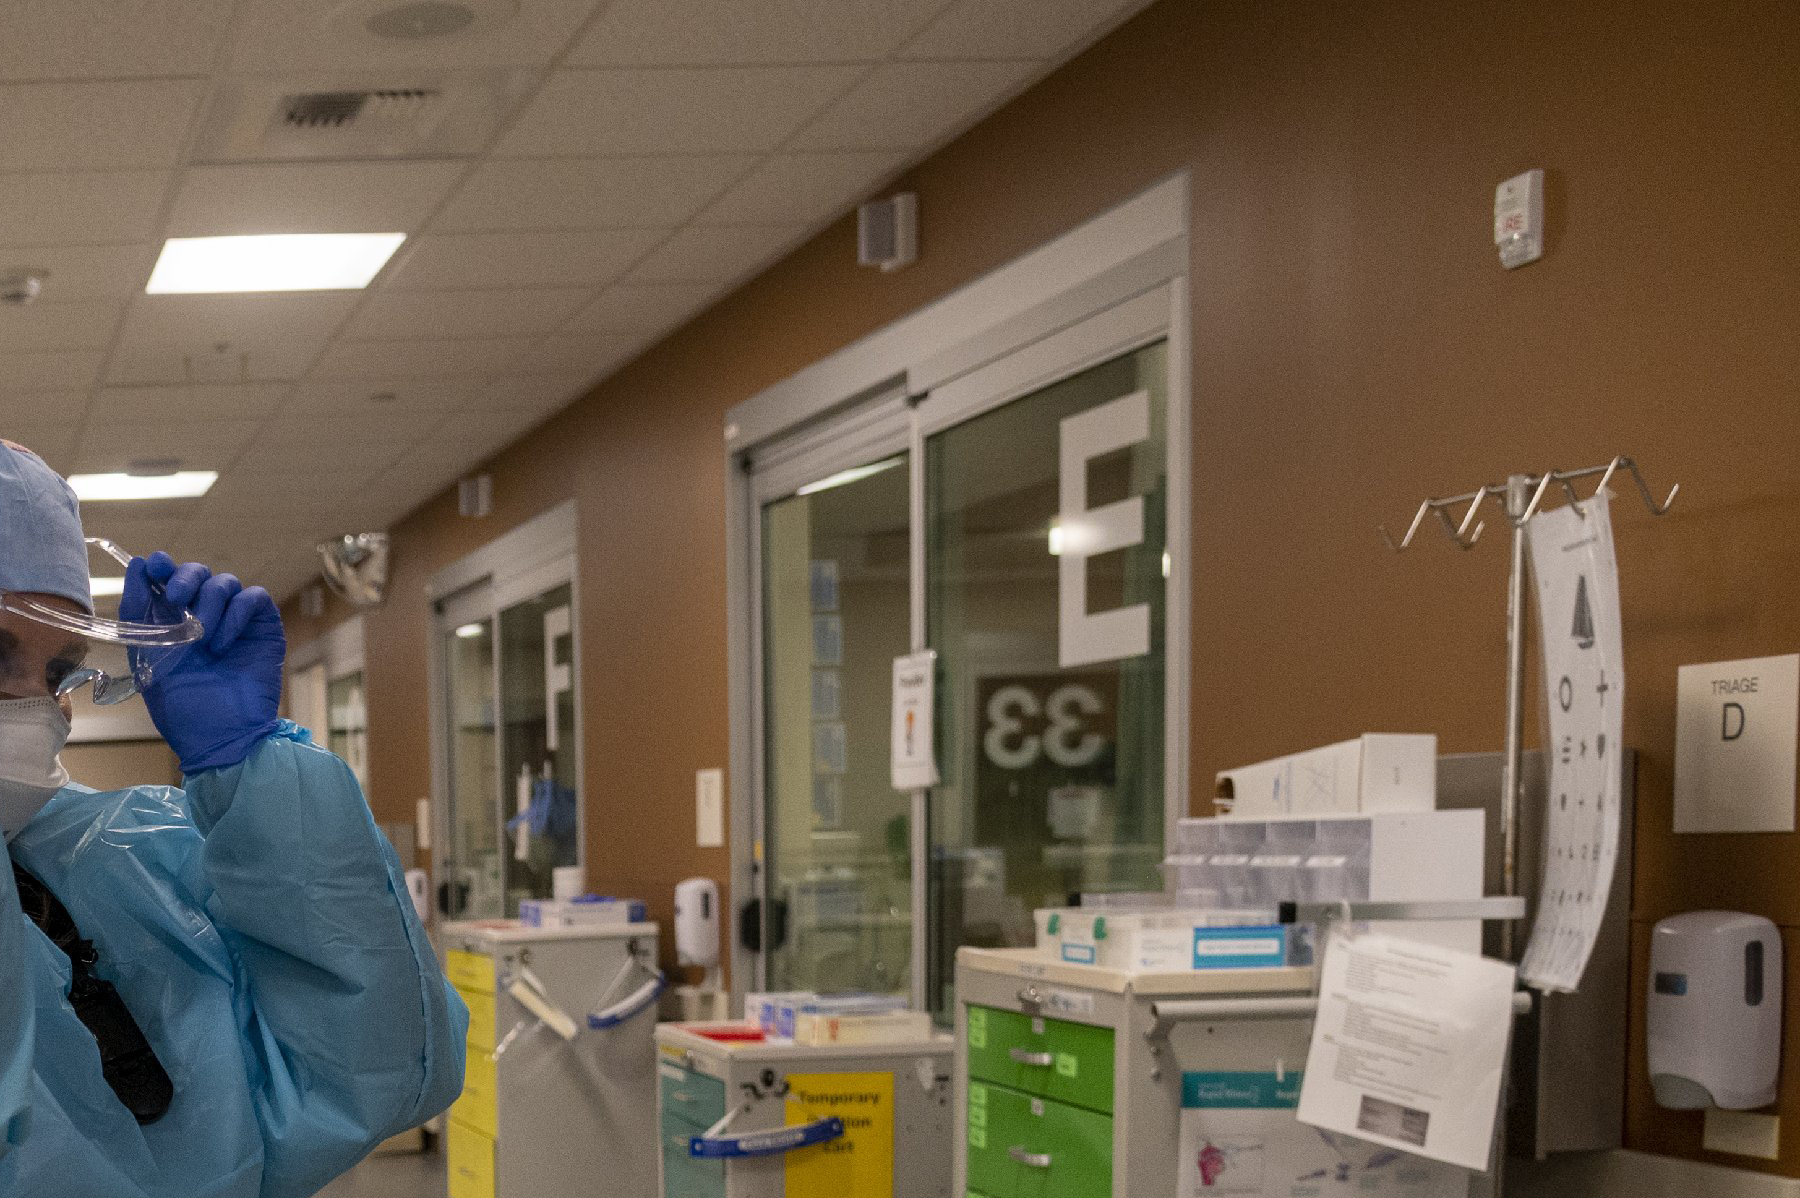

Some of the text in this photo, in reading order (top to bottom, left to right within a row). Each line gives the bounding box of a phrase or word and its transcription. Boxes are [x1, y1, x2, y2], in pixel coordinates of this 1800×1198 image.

[1059, 389, 1150, 668] E
[1711, 677, 1759, 695] TRIAGE
[1721, 701, 1745, 742] D
[800, 1091, 880, 1106] Temporary
